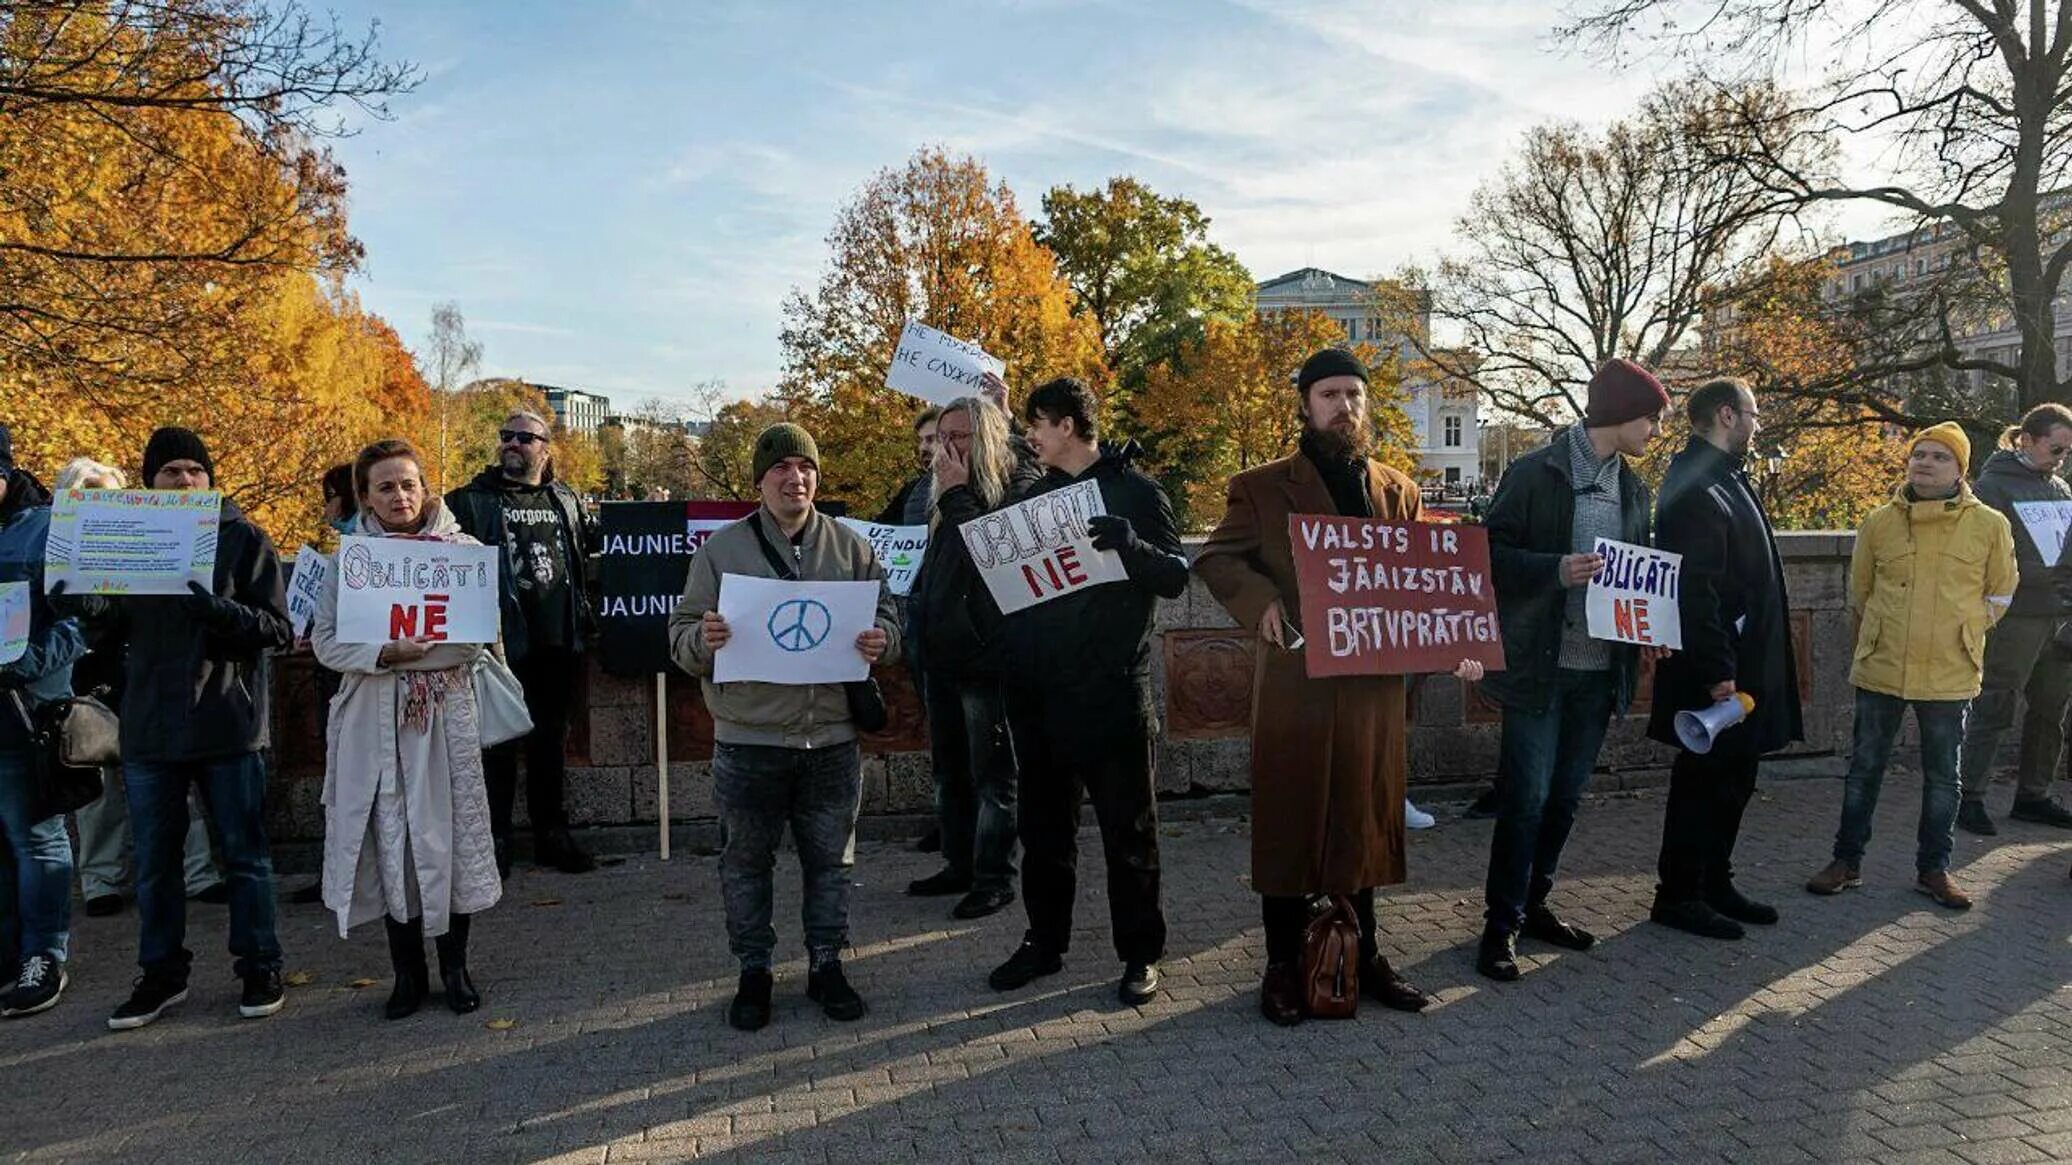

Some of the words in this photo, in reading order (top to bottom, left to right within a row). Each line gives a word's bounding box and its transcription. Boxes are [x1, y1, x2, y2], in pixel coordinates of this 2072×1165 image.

[907, 322, 927, 339] НЕ
[898, 346, 922, 367] НЕ
[1301, 520, 1410, 552] VALSTS
[1430, 529, 1458, 554] IR
[1021, 545, 1089, 598] NĒ
[1327, 556, 1482, 595] JĀAIZSTĀV
[389, 593, 450, 643] NĒ
[1614, 598, 1653, 643] NĒ
